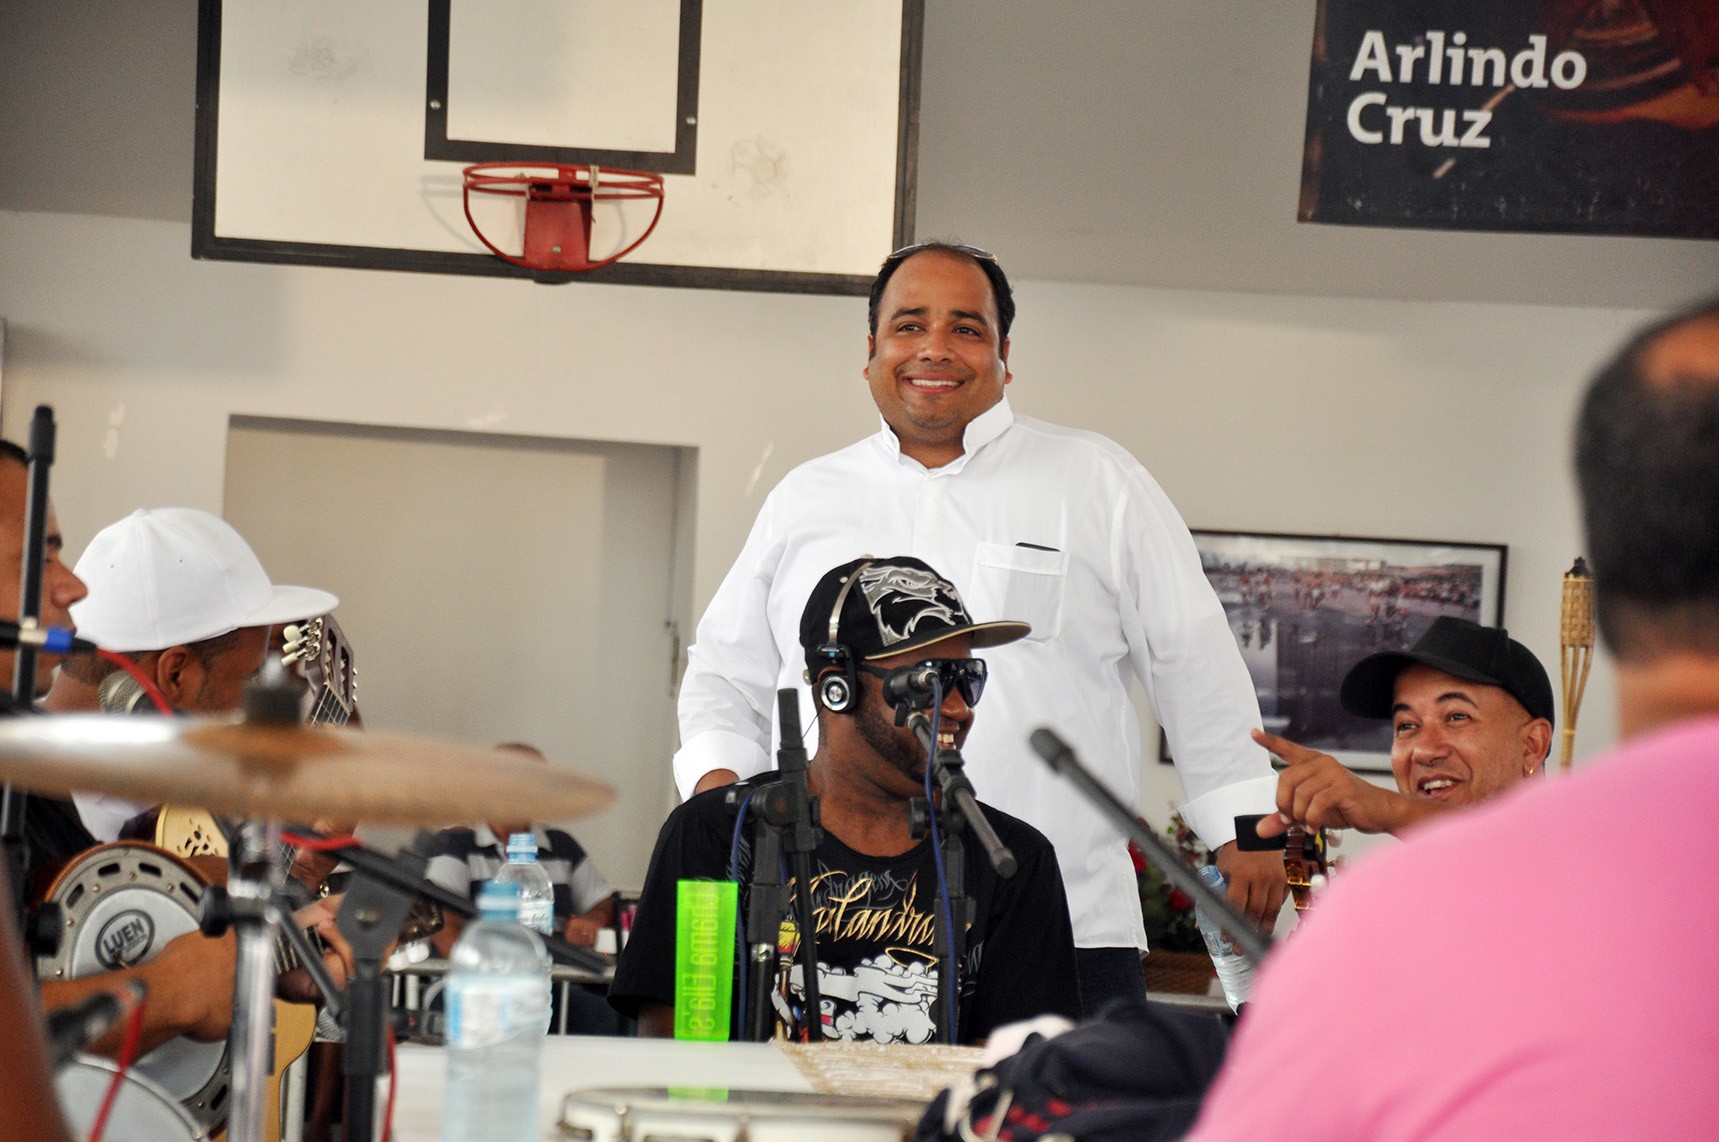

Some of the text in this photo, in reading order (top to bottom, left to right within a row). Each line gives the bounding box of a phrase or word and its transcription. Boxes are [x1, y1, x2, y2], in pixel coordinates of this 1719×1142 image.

[1349, 29, 1588, 90] Arlindo
[1347, 91, 1493, 149] Cruz
[104, 918, 144, 954] LUEN
